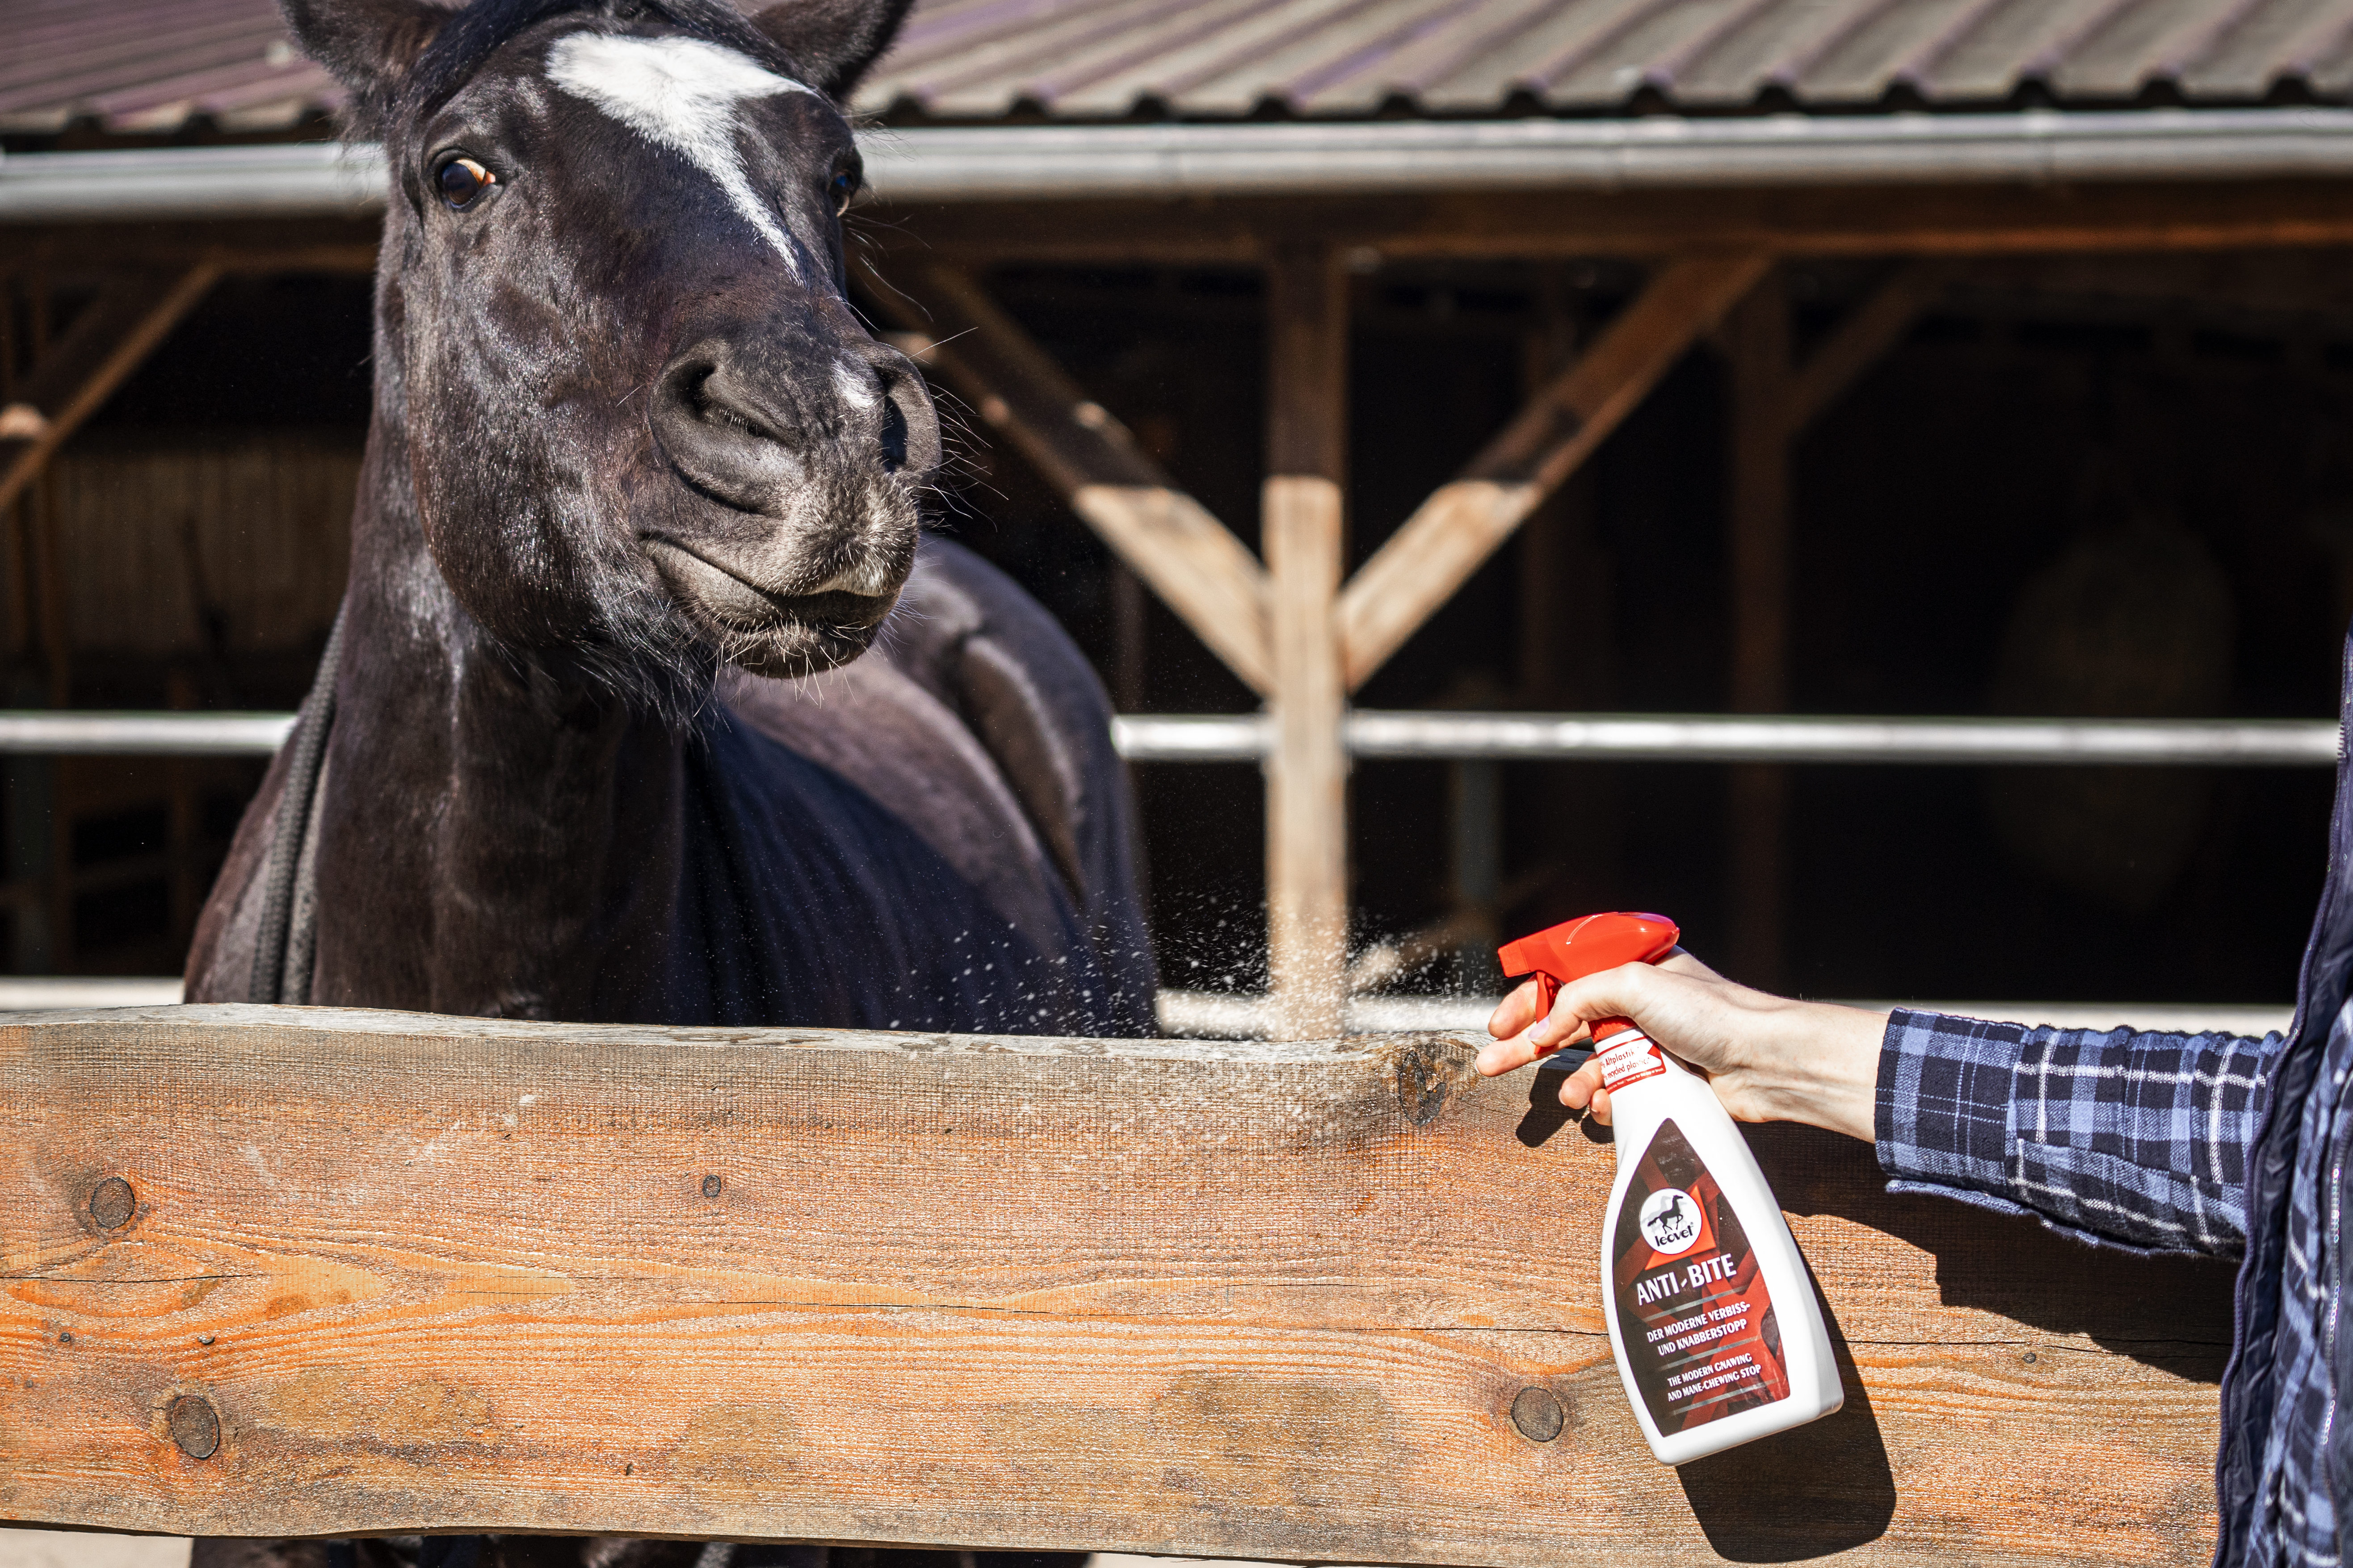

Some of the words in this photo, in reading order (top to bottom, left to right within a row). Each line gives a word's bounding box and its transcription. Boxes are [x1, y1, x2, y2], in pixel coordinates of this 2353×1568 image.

[1655, 1225, 1693, 1246] leovet
[1647, 1329, 1664, 1342] DER
[1664, 1314, 1708, 1337] MODERNE
[1708, 1301, 1750, 1321] VERBISS-
[1657, 1342, 1676, 1356] UND
[1676, 1319, 1747, 1350] KNABBERSTOPP
[1667, 1375, 1682, 1387] THE
[1682, 1365, 1714, 1382] MODERN
[1714, 1353, 1752, 1371] GNAWING
[1668, 1390, 1682, 1401] AND
[1683, 1371, 1740, 1396] MANE-CHEWING
[1740, 1364, 1761, 1378] STOP
